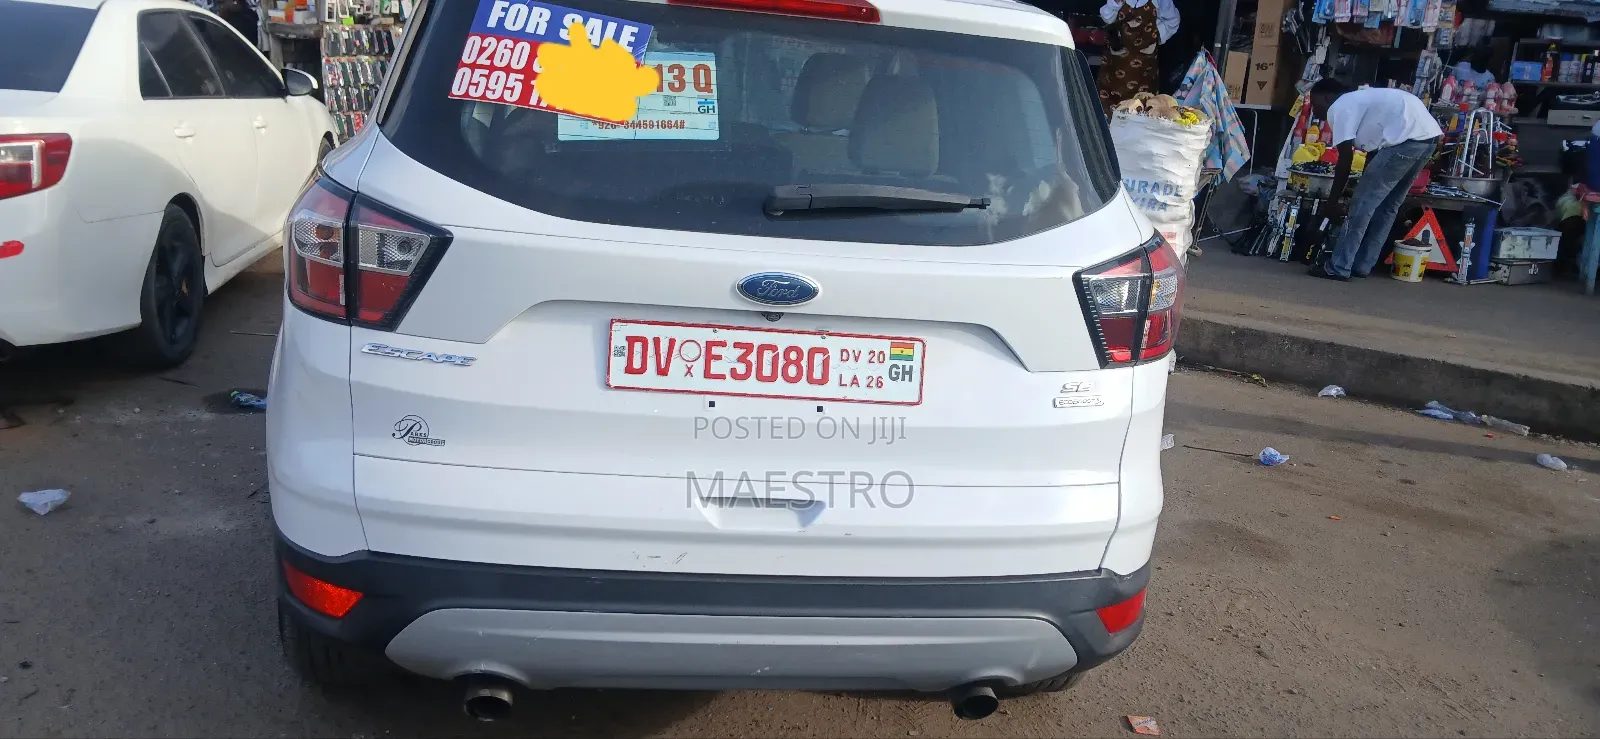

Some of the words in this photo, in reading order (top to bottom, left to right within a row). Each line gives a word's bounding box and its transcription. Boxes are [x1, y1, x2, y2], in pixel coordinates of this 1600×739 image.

[487, 1, 551, 36] FOR
[462, 36, 531, 70] 0260
[1255, 62, 1274, 71] 16"
[451, 67, 525, 103] 0595
[693, 63, 713, 94] Q
[697, 105, 716, 114] GH
[1133, 197, 1168, 212] IRA
[757, 279, 801, 298] Ford
[361, 343, 477, 367] ESCAPE
[624, 335, 677, 377] DV
[703, 340, 831, 386] E3080
[840, 348, 862, 363] DV
[868, 349, 887, 364] 20
[838, 373, 861, 388] LA
[866, 375, 885, 389] 26
[888, 363, 914, 383] GH
